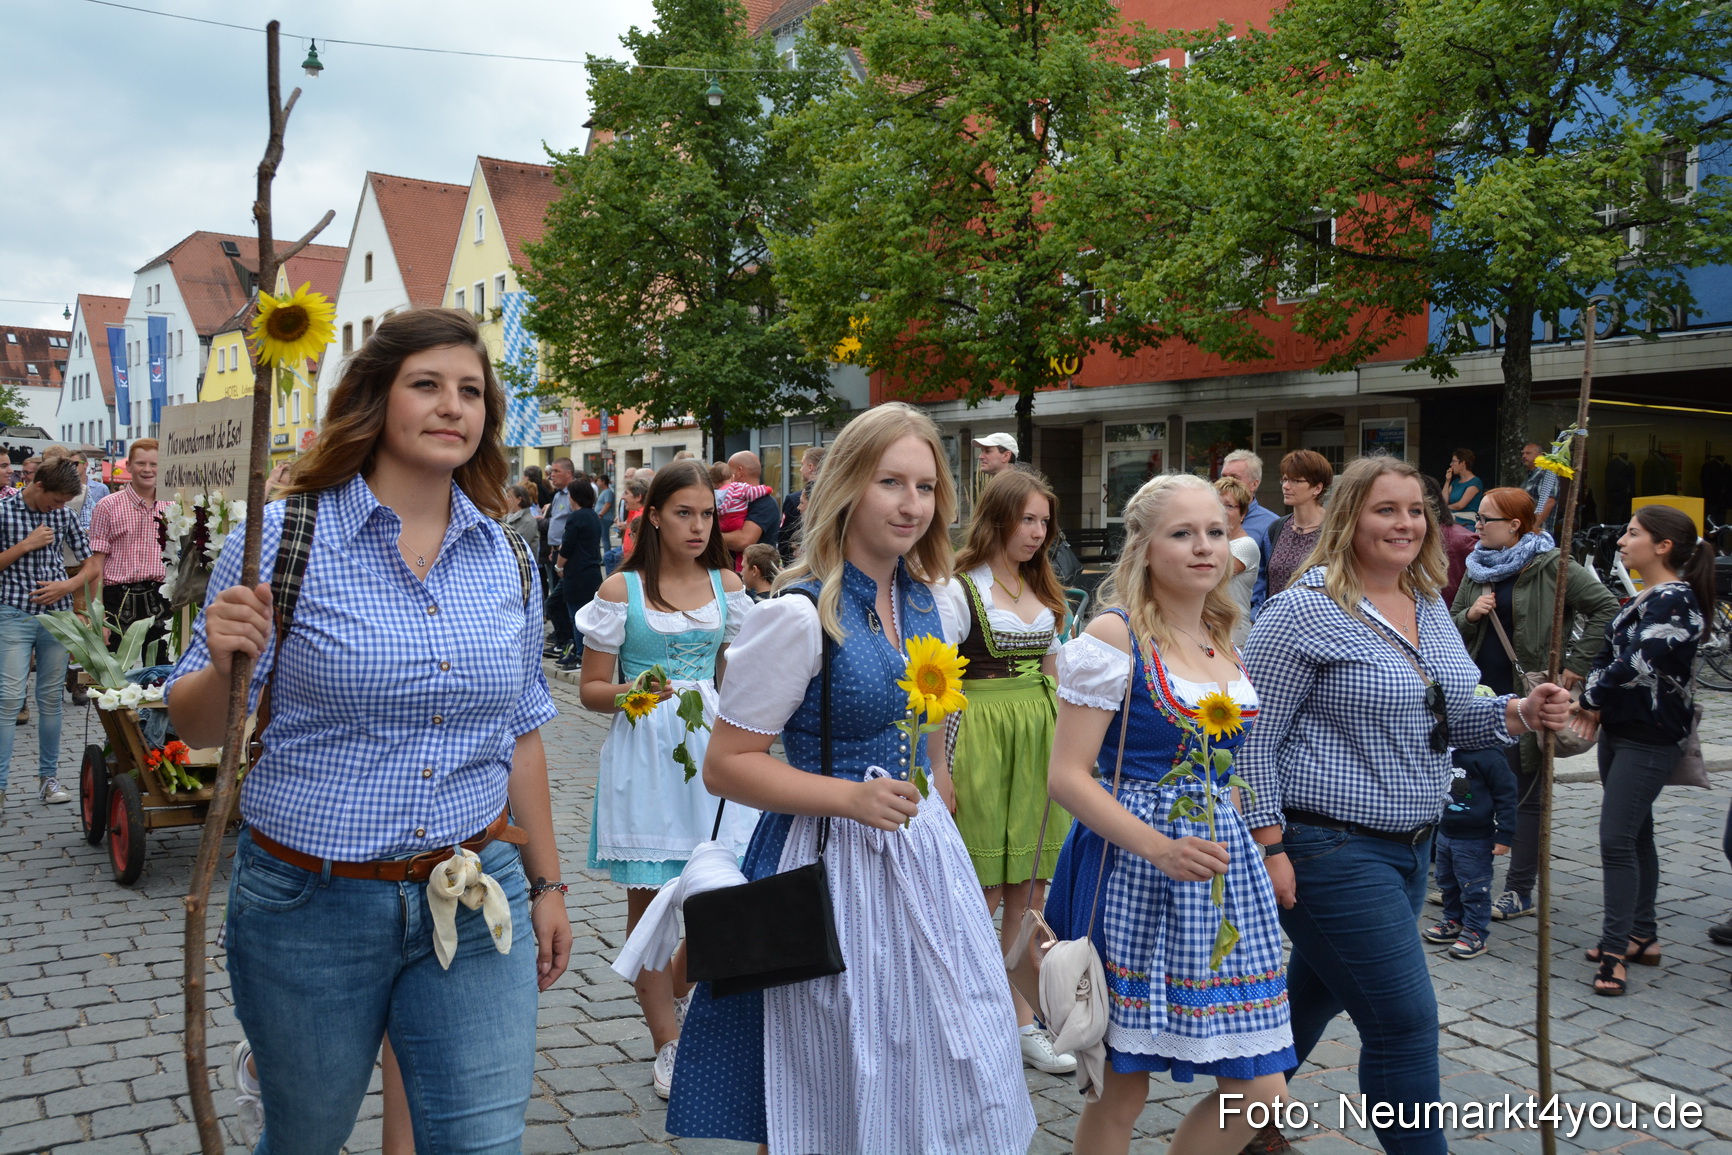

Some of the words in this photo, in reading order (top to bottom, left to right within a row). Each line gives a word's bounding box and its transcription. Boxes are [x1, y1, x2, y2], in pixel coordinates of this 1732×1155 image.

[1117, 348, 1190, 380] JOSEF
[225, 385, 239, 397] HOTEL
[205, 424, 216, 450] mit
[226, 419, 242, 448] Esel
